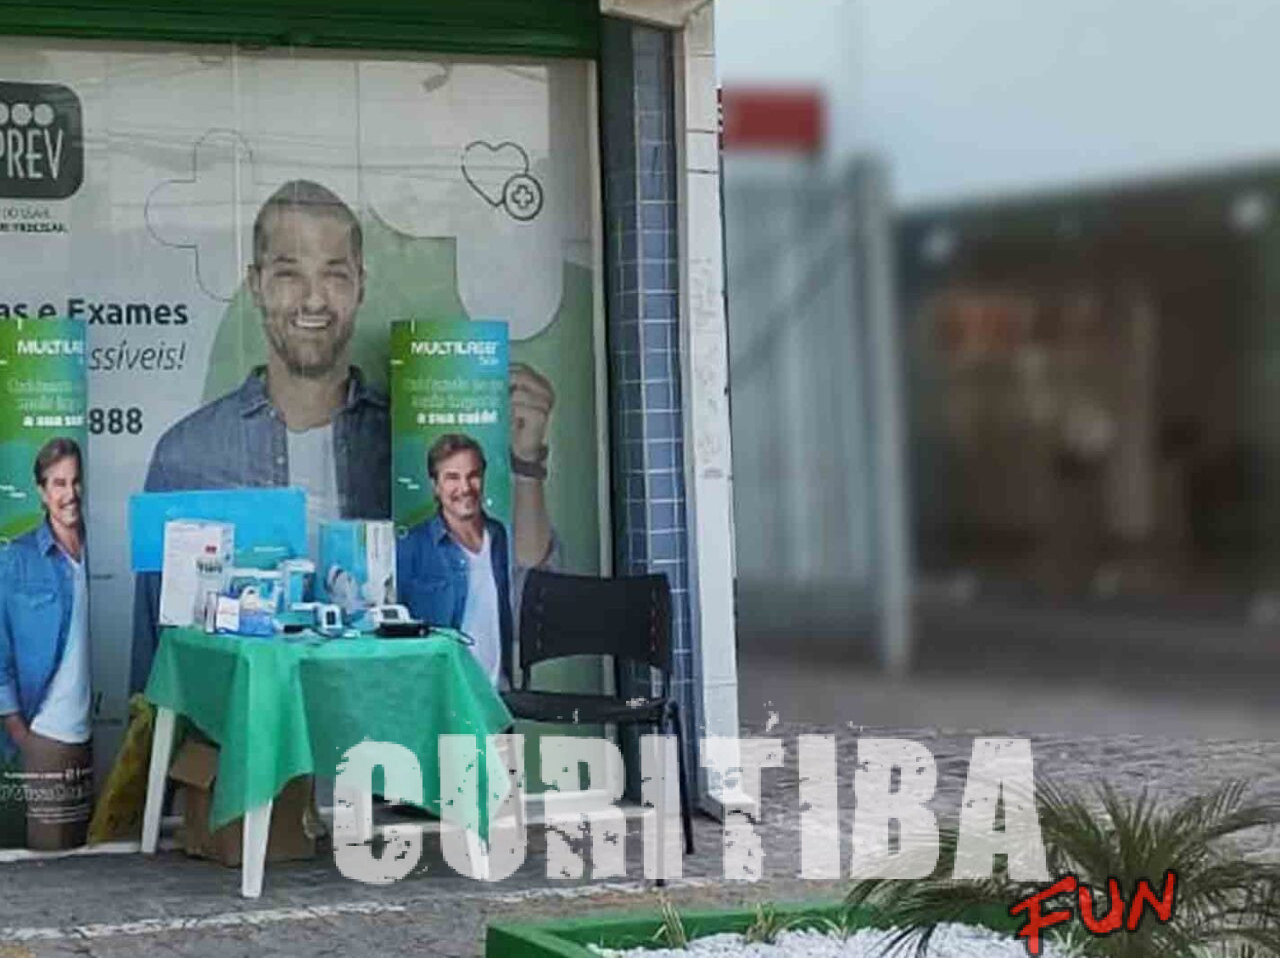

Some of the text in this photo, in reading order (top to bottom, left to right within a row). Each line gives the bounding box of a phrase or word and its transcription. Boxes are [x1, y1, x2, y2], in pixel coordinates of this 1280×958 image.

[37, 304, 57, 319] e
[68, 298, 188, 325] Exames
[89, 341, 187, 370] ssíveis!
